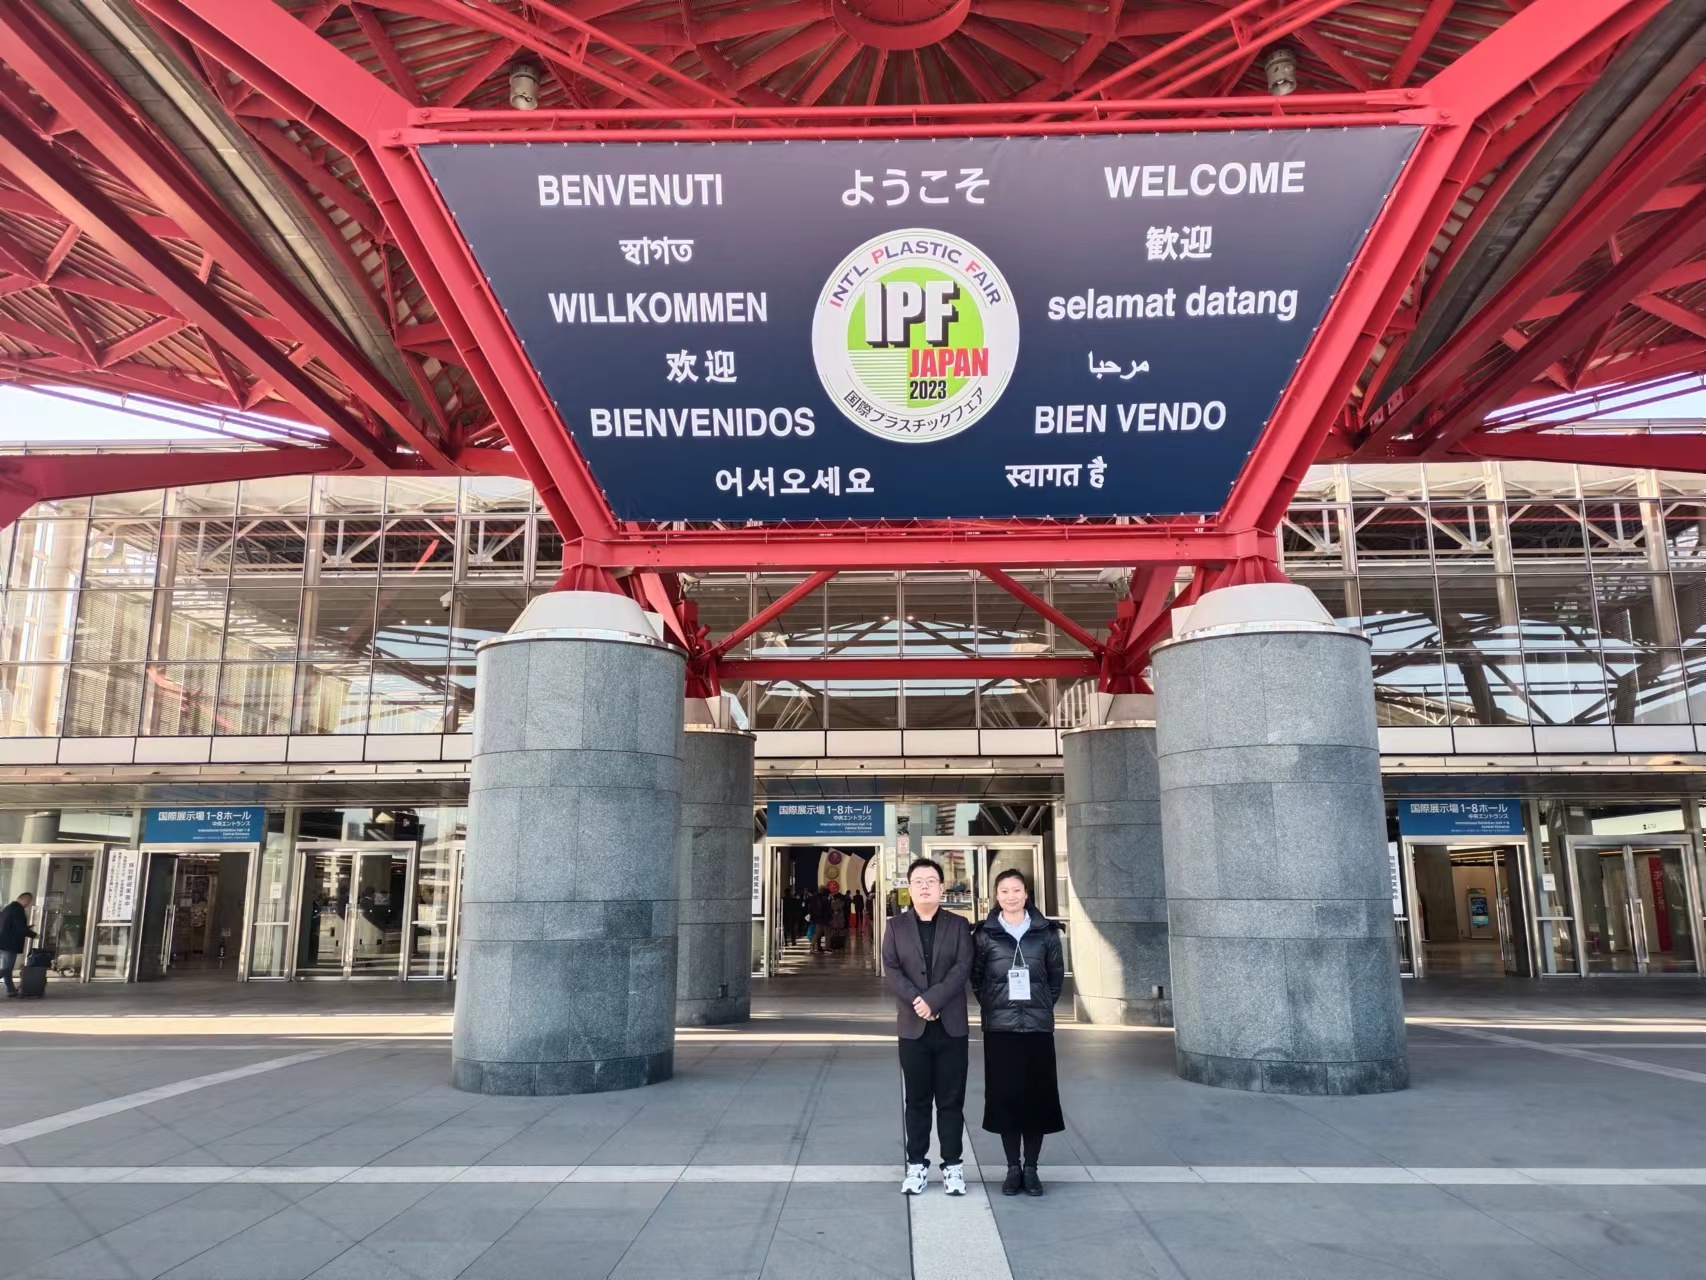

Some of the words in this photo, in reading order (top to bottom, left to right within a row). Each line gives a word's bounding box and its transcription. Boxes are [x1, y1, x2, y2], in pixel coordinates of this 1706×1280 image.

[538, 173, 723, 207] BENVENUTI
[841, 167, 990, 207] ようこそ
[1103, 160, 1306, 199] WELCOME
[618, 236, 695, 266] স্বাগত
[1145, 225, 1213, 261] 歓迎
[871, 239, 962, 264] PLASTIC
[965, 259, 1002, 305] FAIR
[547, 291, 768, 325] WILLKOMMEN
[864, 280, 961, 349] IPF
[1047, 287, 1177, 321] selamat
[1185, 286, 1298, 322] datang
[909, 347, 989, 378] JAPAN
[1088, 350, 1150, 380] مرحبا
[909, 380, 947, 400] 2023
[590, 407, 815, 438] BIENVENIDOS
[843, 386, 984, 433] 国際プラスチックフェア
[1035, 404, 1107, 434] BIEN
[1116, 400, 1227, 433] VENDO
[715, 466, 875, 497] 어서오세요
[1005, 463, 1083, 488] स्वागत
[1087, 455, 1108, 489] है
